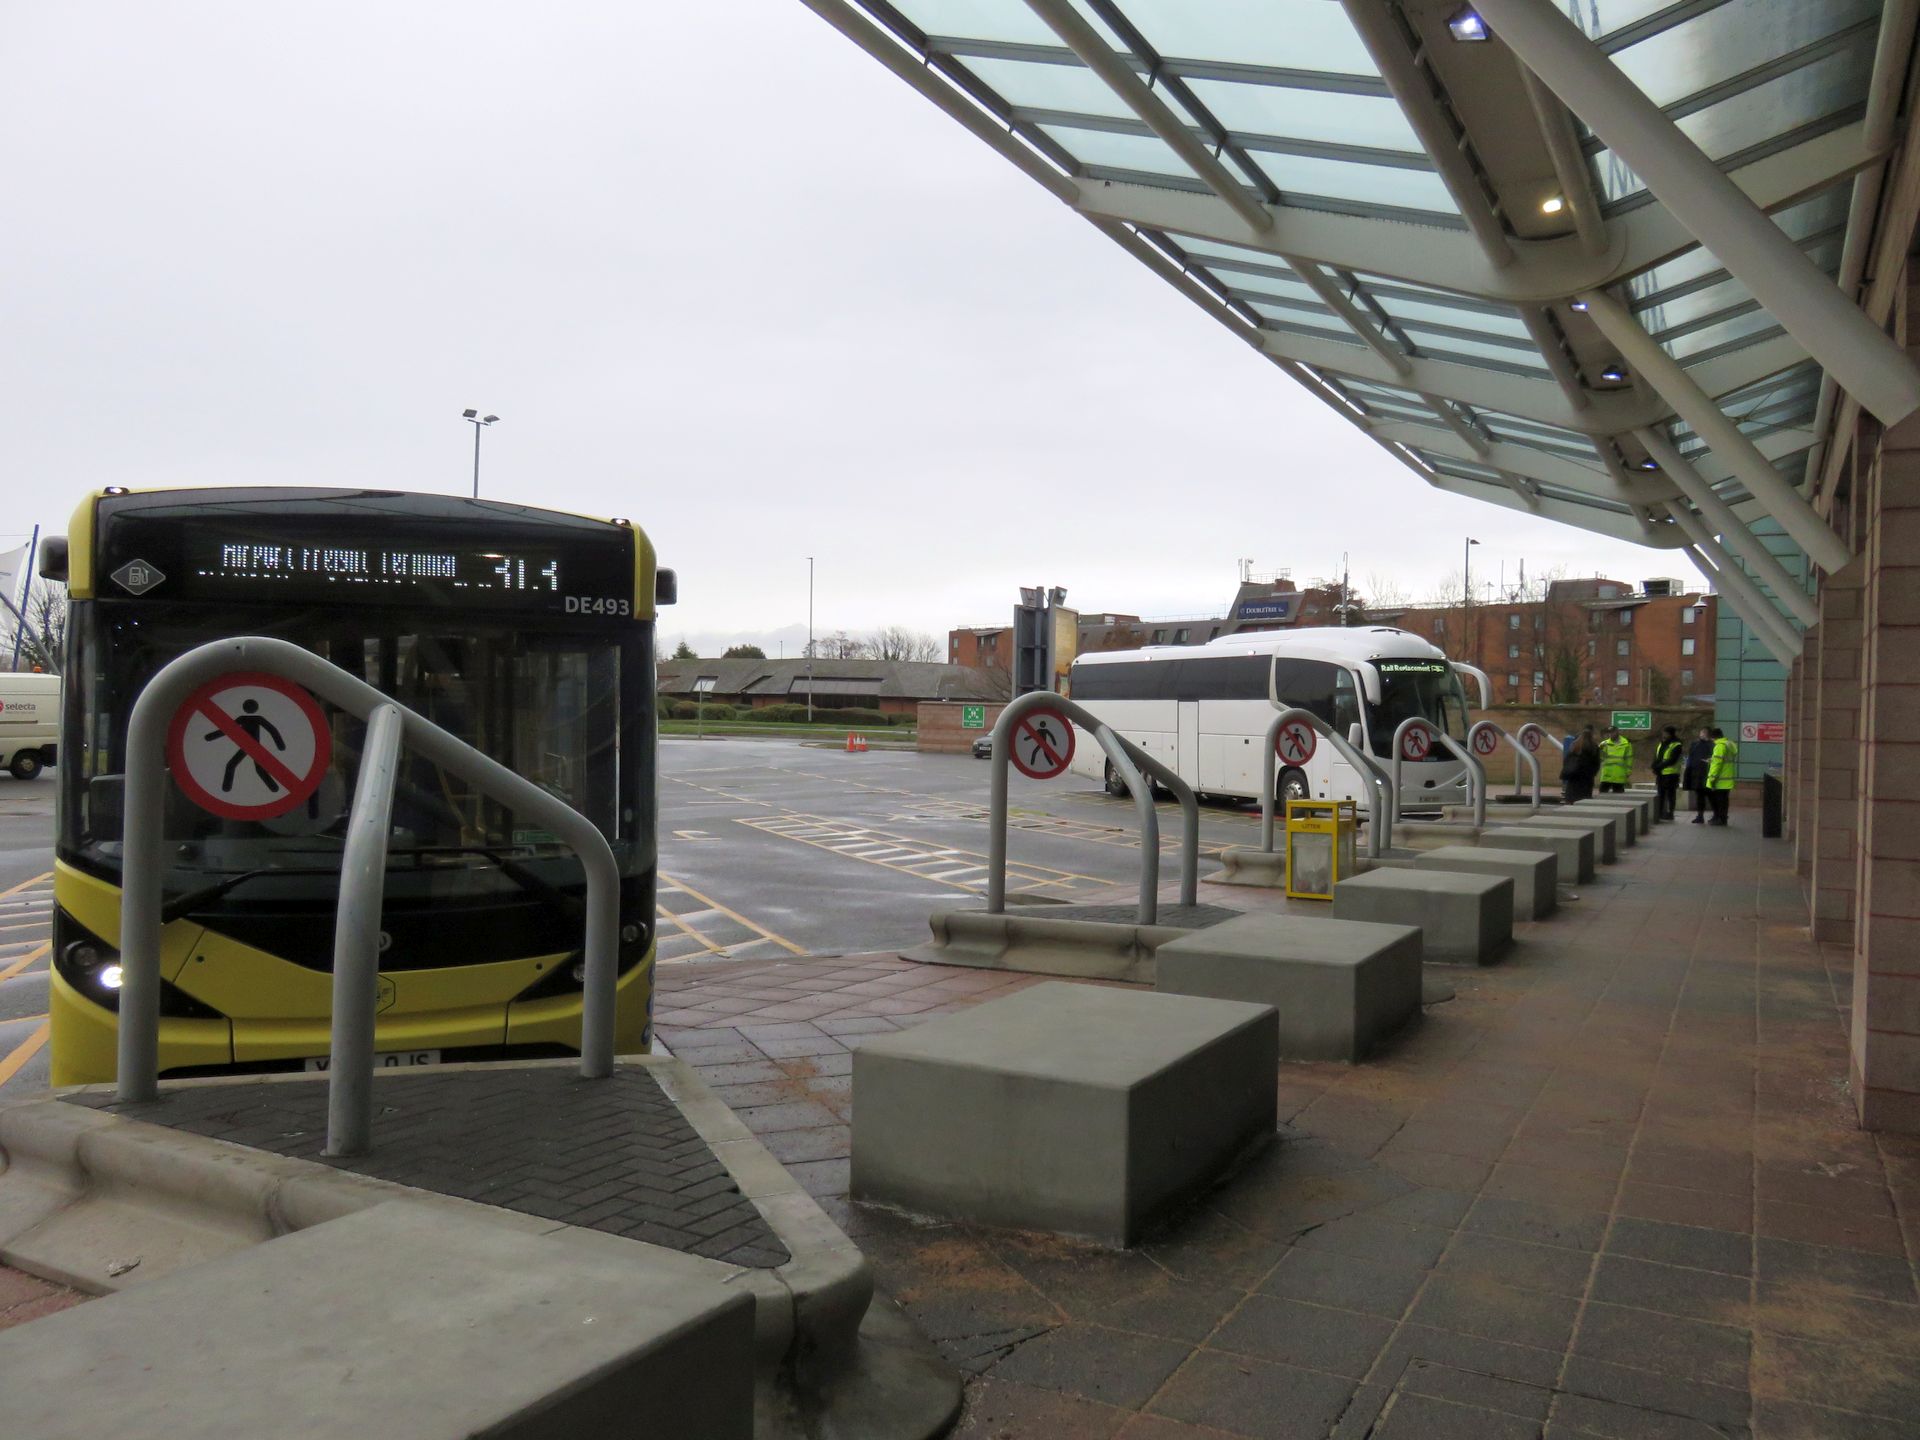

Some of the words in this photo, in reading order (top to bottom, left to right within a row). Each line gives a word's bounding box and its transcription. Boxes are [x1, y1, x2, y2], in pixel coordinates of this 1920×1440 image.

[565, 596, 630, 616] DE493
[1381, 664, 1394, 672] Rail
[1394, 664, 1431, 672] Replacement
[5, 703, 36, 711] selecta
